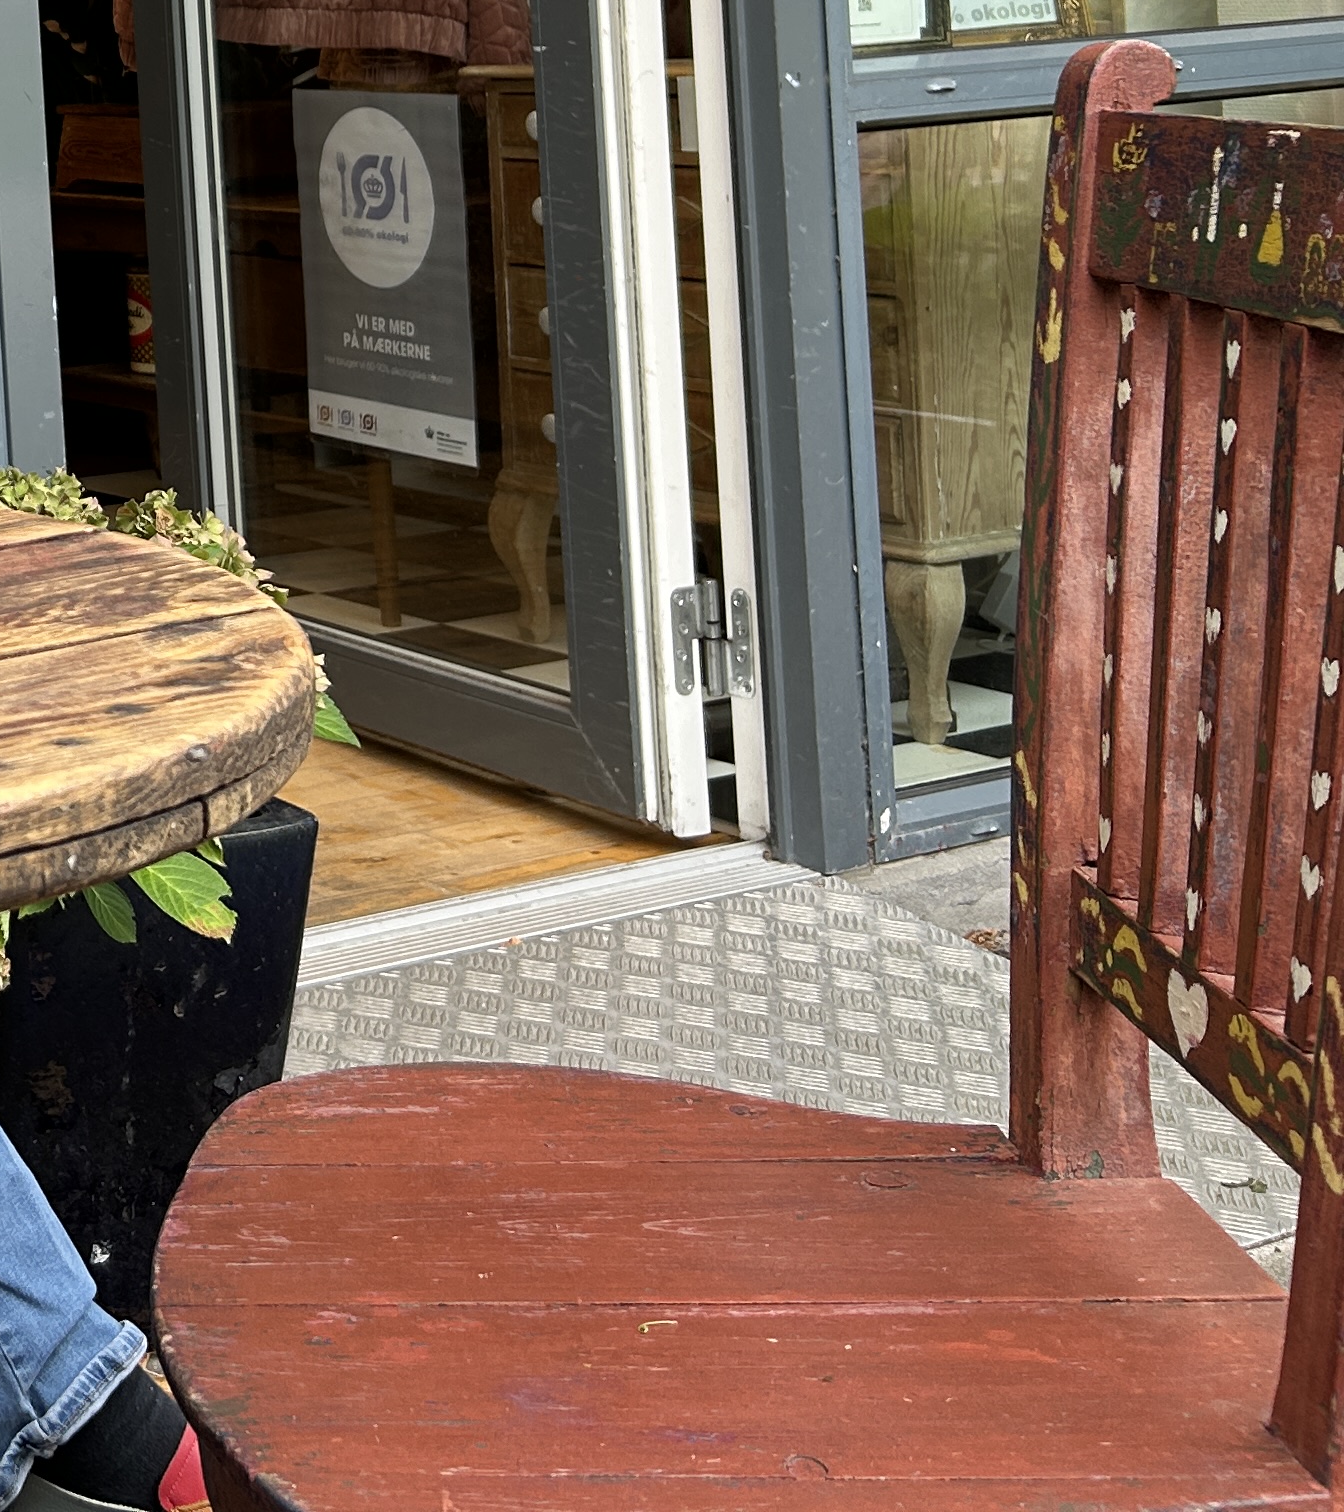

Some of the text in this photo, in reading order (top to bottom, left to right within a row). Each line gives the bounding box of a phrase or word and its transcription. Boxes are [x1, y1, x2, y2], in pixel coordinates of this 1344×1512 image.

[376, 230, 409, 244] økologi
[355, 313, 415, 337] VI ER MED
[343, 328, 431, 361] PÅ MÆRKERNE
